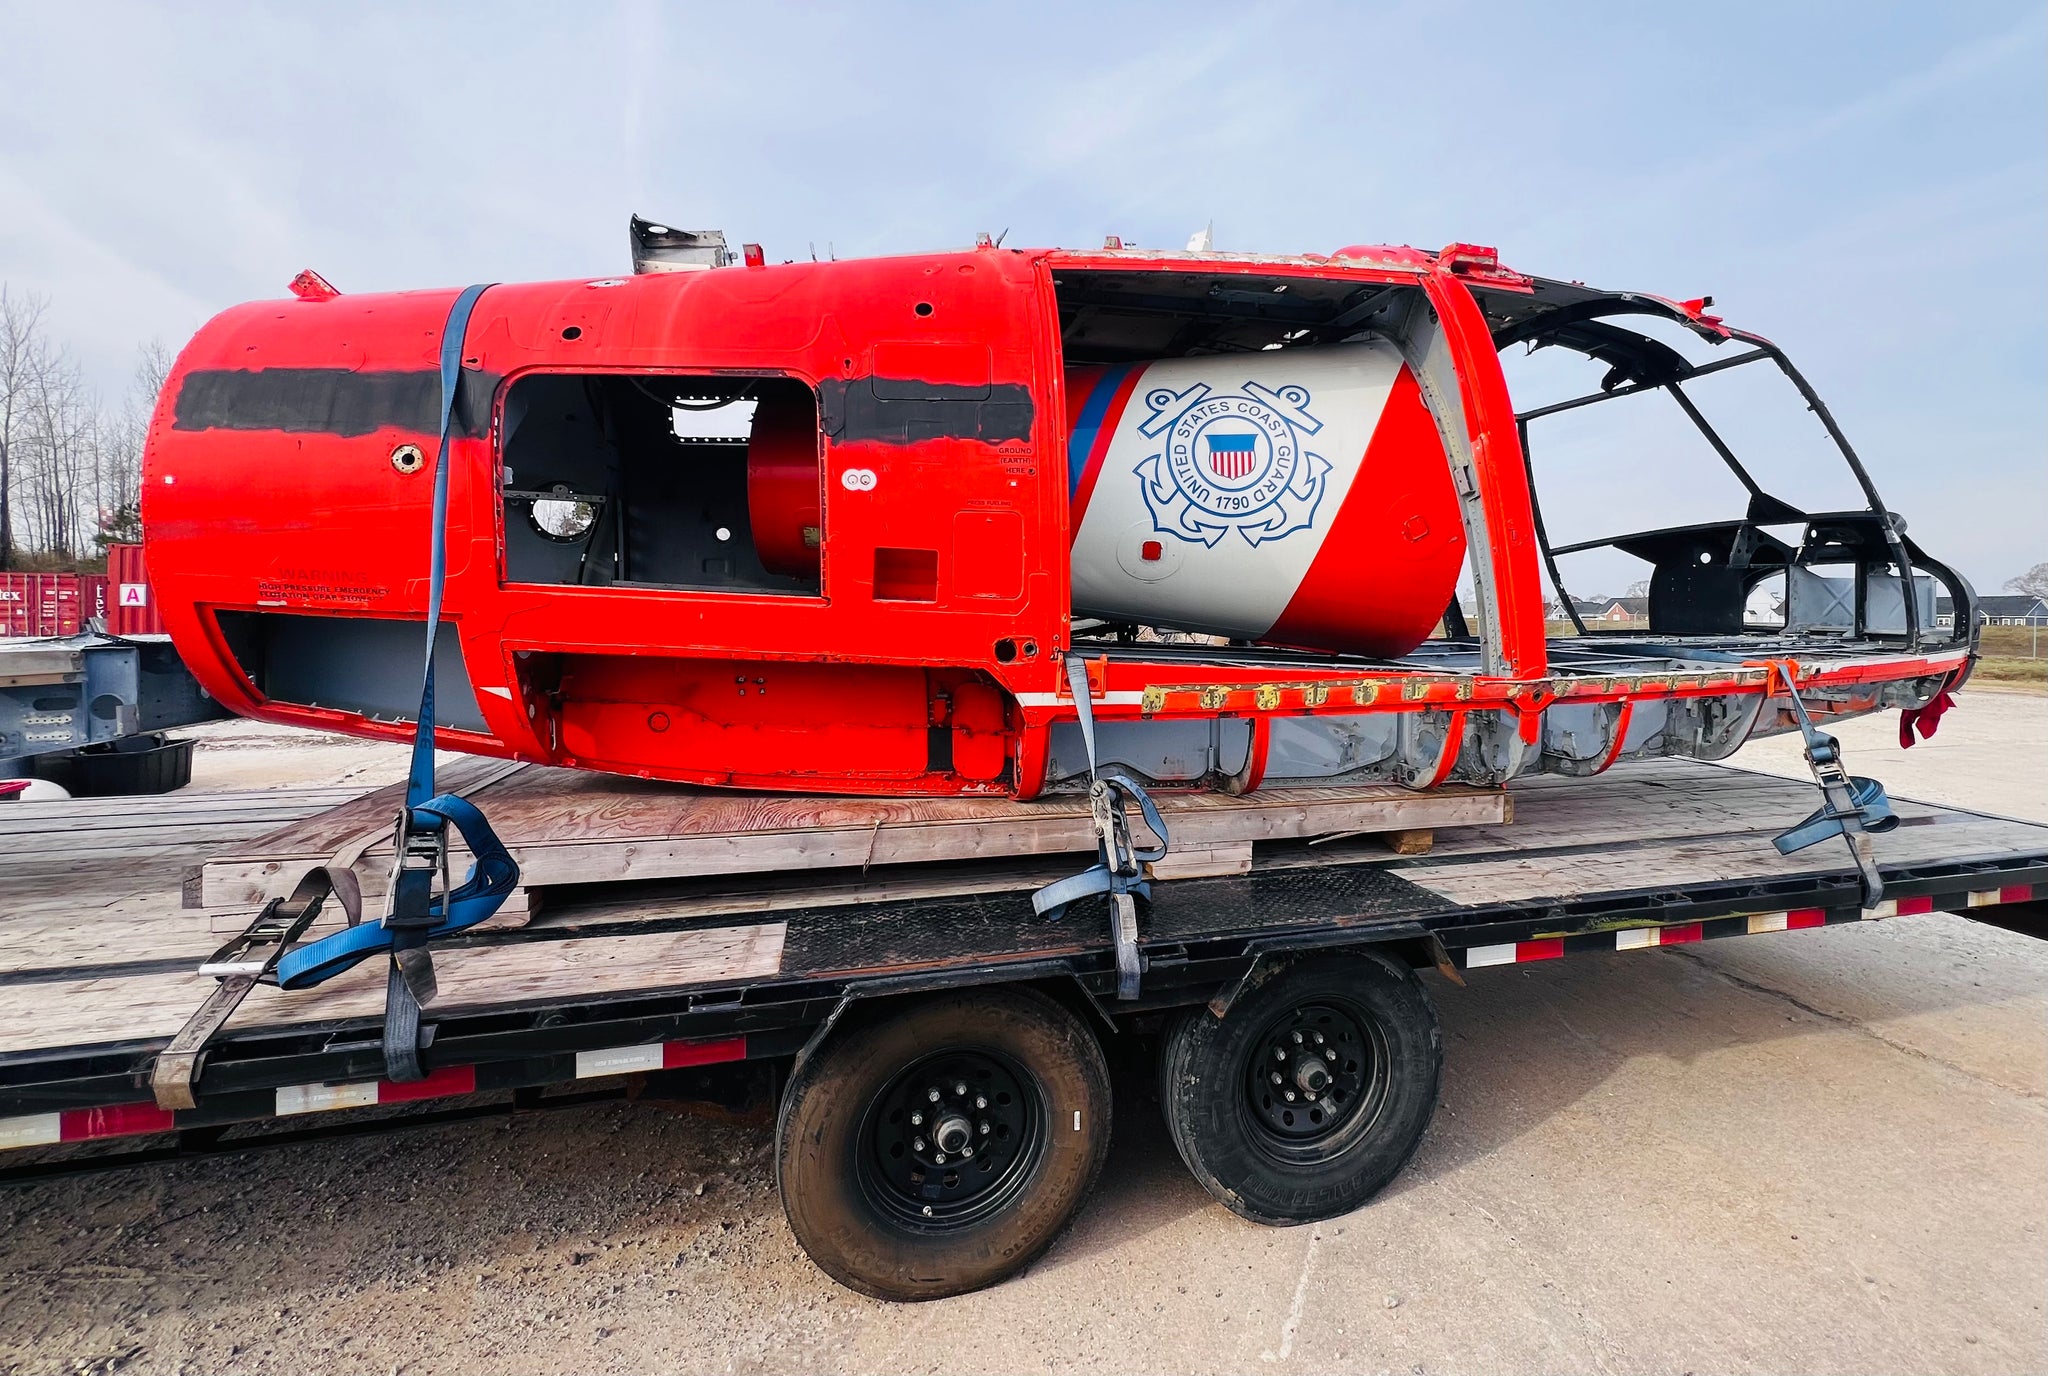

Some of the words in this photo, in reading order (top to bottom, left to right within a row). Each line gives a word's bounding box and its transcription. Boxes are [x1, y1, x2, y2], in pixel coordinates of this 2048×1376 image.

[1178, 401, 1230, 438] STATES
[1237, 402, 1287, 439] COAST
[1174, 444, 1210, 502] UNITED
[1254, 445, 1291, 502] GUARD
[1215, 495, 1250, 510] 1790
[259, 582, 281, 590] HIGH
[284, 584, 331, 592] PRESSURE
[334, 586, 391, 595] EMERGENCY
[280, 568, 367, 583] WARNING
[126, 588, 140, 602] A
